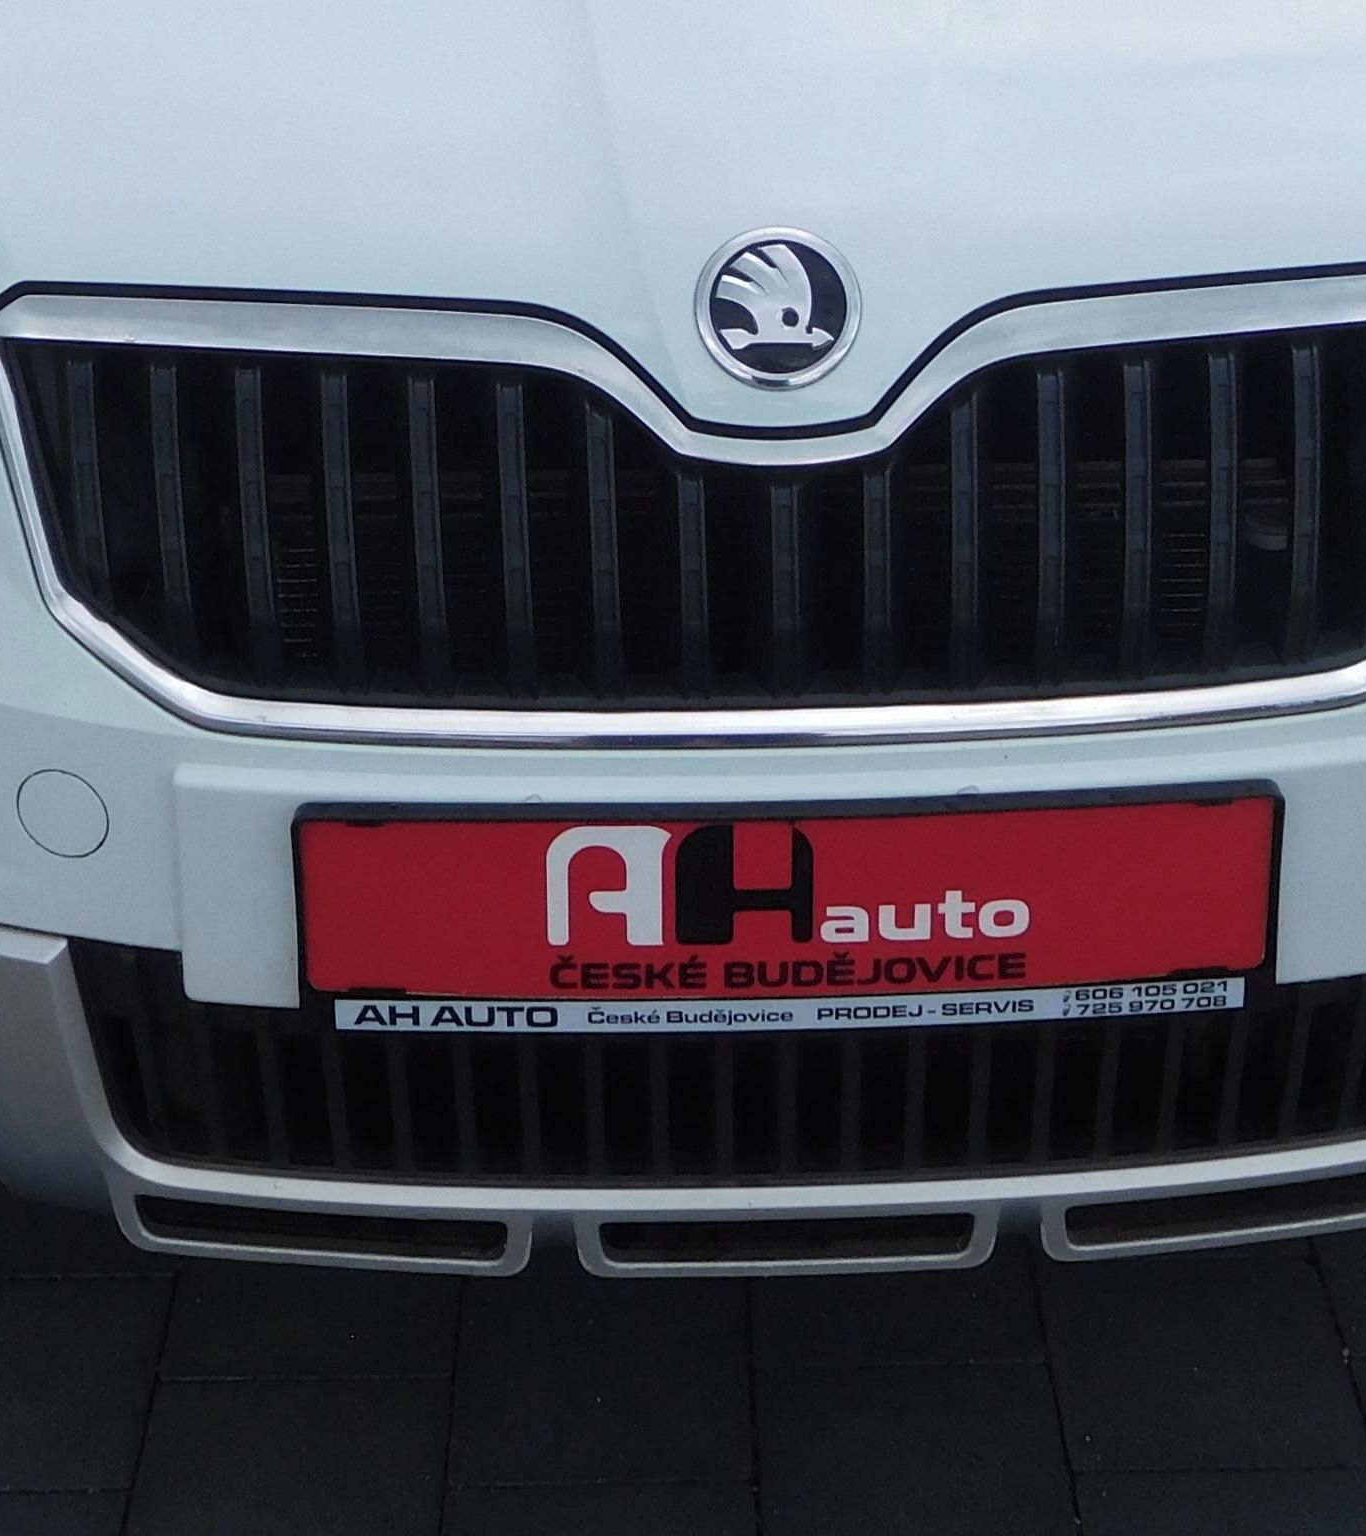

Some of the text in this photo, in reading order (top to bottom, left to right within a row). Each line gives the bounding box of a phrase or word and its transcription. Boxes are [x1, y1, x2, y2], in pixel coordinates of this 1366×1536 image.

[549, 952, 1027, 990] ČESKÉ BUDĚJOVICE
[1075, 980, 1228, 1001] 606 105 021
[1076, 995, 1227, 1015] 725 970 708
[354, 1005, 420, 1026] AH
[431, 1005, 558, 1027] AUTO
[587, 1007, 661, 1024] České
[666, 1009, 794, 1025] Budějovice
